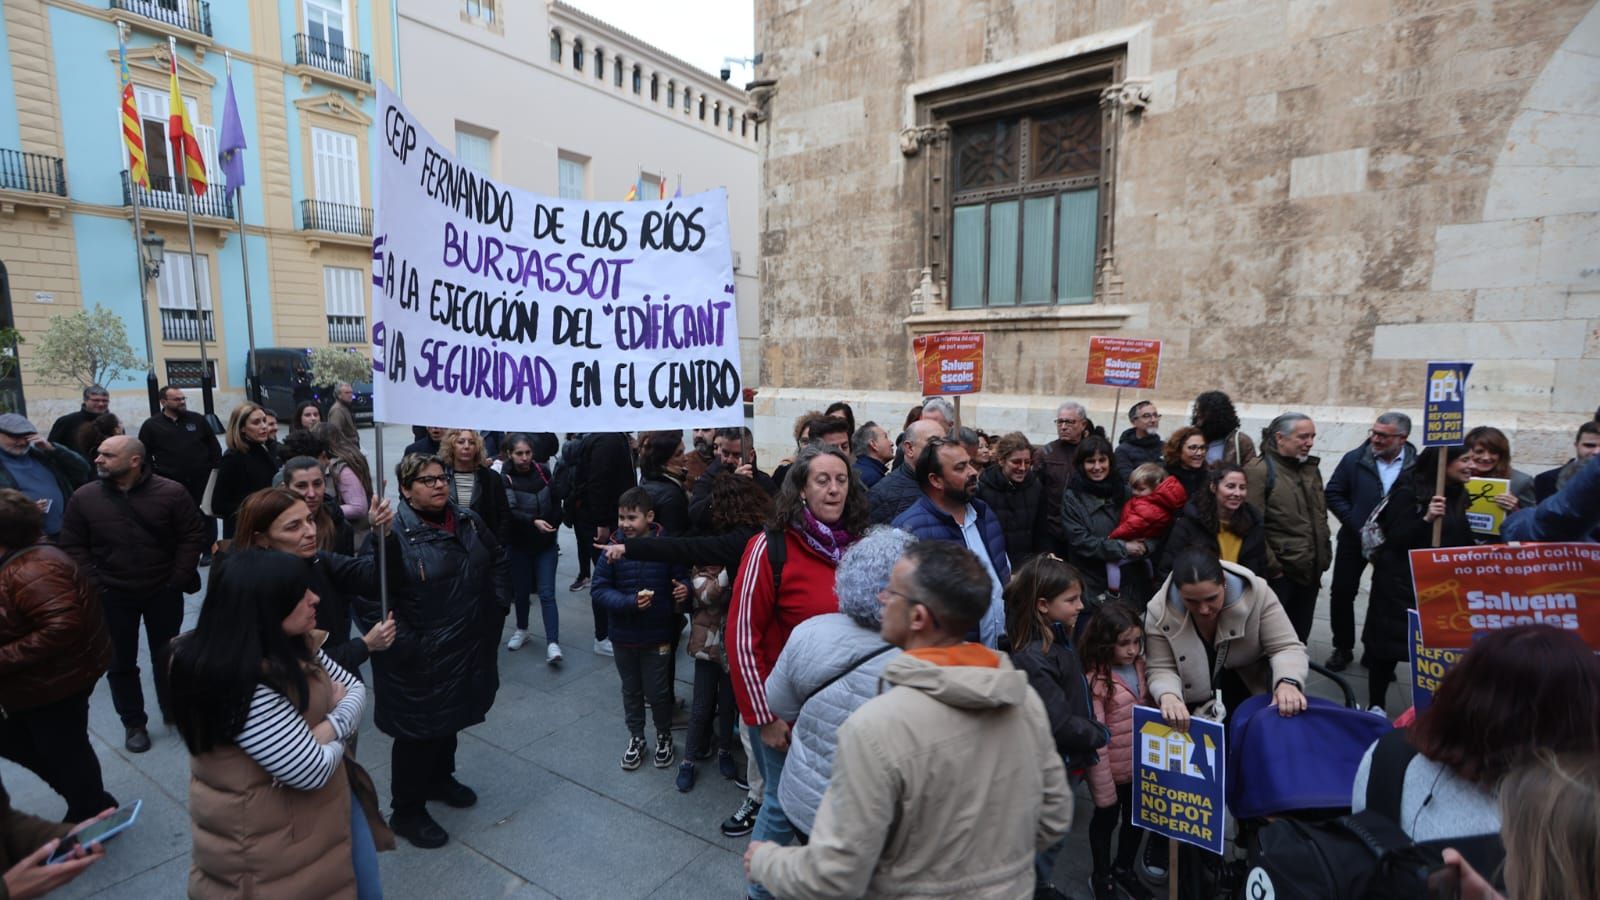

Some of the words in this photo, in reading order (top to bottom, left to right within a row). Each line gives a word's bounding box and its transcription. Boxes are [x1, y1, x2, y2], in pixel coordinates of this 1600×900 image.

[385, 105, 417, 165] CEIP
[420, 147, 513, 233] FERNANDO
[533, 204, 566, 244] DE
[581, 209, 628, 251] LOS
[640, 201, 706, 251] RÍOS
[443, 222, 634, 300] BURJASSOT
[386, 251, 394, 299] A
[400, 259, 419, 312] LA
[430, 279, 539, 345] EJECUCIÓN
[552, 305, 602, 349] DEL
[413, 337, 557, 408] SEGURIDAD
[570, 360, 602, 409] EN
[613, 361, 644, 409] EL
[648, 358, 741, 411] CENTRO
[941, 370, 974, 383] escoles
[1428, 421, 1441, 431] NO
[1444, 420, 1461, 431] POT
[1432, 552, 1450, 563] La
[1453, 548, 1512, 562] reforma
[1516, 547, 1540, 560] del
[1455, 566, 1472, 575] no
[1476, 563, 1501, 576] pot
[1505, 561, 1583, 576] esperar!!!
[1467, 590, 1577, 611] Salvem
[1467, 611, 1579, 630] escoles
[1417, 657, 1445, 678] NO
[1141, 768, 1157, 782] LA
[1141, 782, 1213, 810] REFORMA
[1141, 793, 1168, 813] NO
[1171, 802, 1212, 825] POT
[1141, 808, 1213, 841] ESPERAR
